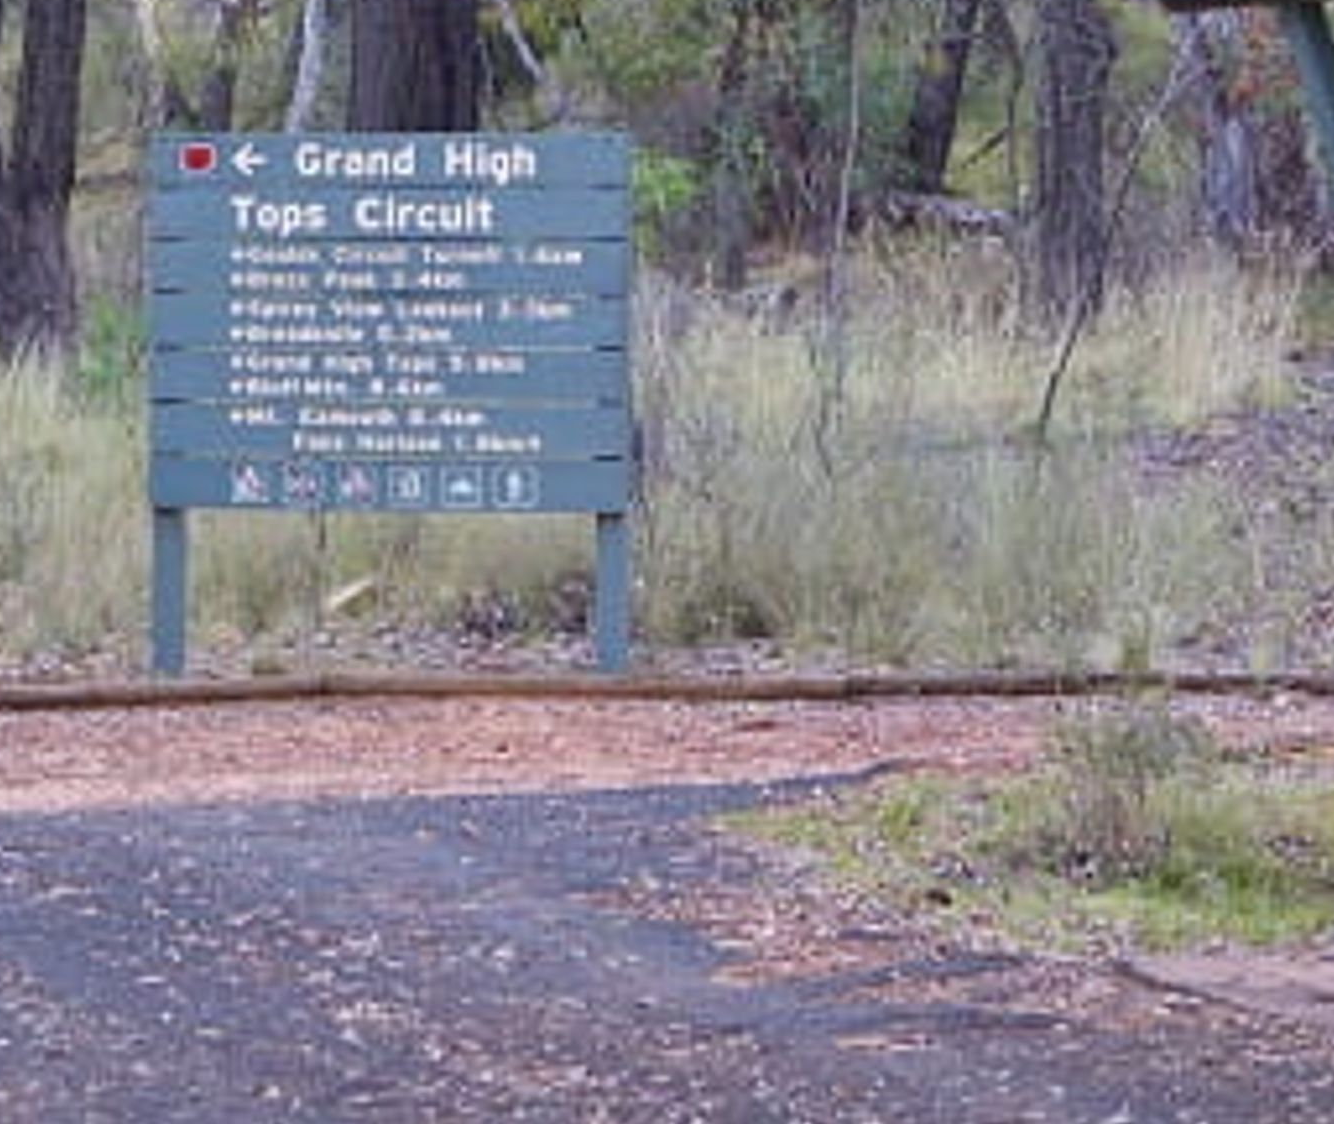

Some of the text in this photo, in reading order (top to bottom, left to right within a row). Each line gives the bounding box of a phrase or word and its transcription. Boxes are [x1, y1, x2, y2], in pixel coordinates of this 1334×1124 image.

[294, 140, 537, 185] Grand High
[231, 193, 494, 236] Tops Circuit
